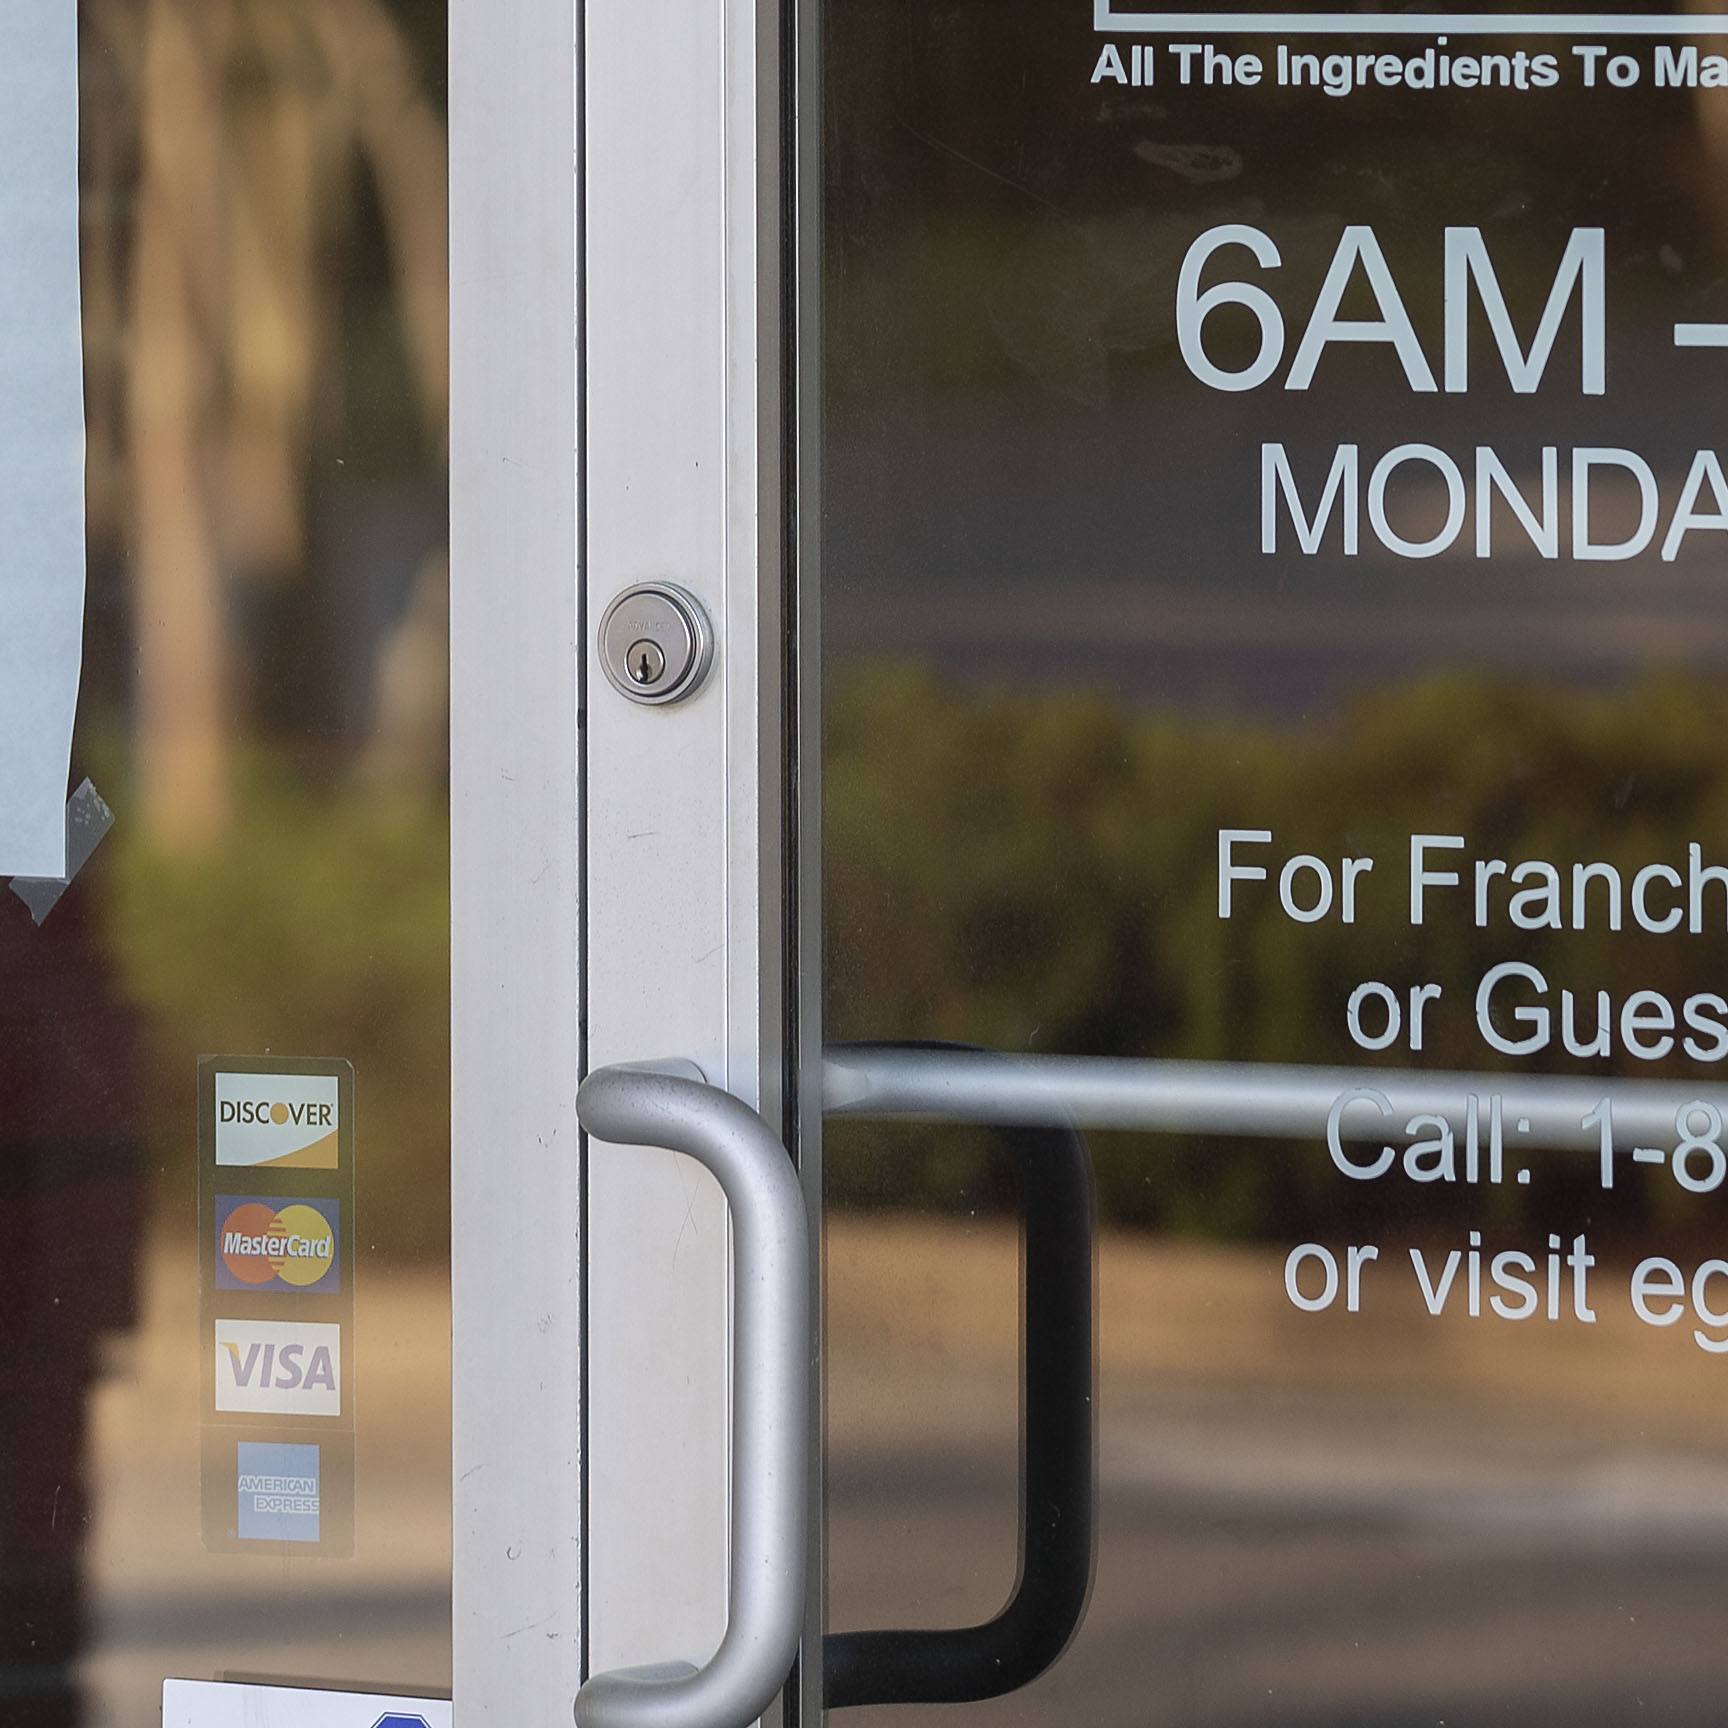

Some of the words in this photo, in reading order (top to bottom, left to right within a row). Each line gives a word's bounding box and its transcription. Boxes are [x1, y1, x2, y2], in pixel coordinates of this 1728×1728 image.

[1091, 44, 1153, 86] All
[1169, 45, 1262, 85] The
[1278, 37, 1559, 96] Ingredients
[1572, 46, 1639, 86] To
[1177, 225, 1605, 395] 6AM
[1219, 830, 1373, 923] For
[1347, 982, 1441, 1049] or
[220, 1100, 334, 1127] DISCOVER
[1326, 1086, 1533, 1185] Call:
[223, 1232, 332, 1259] MasterCard
[1285, 1244, 1378, 1312] or
[1410, 1232, 1596, 1323] visit
[220, 1342, 335, 1390] VISA
[238, 1475, 316, 1495] AMERICAN
[254, 1495, 319, 1514] EXPRESS
